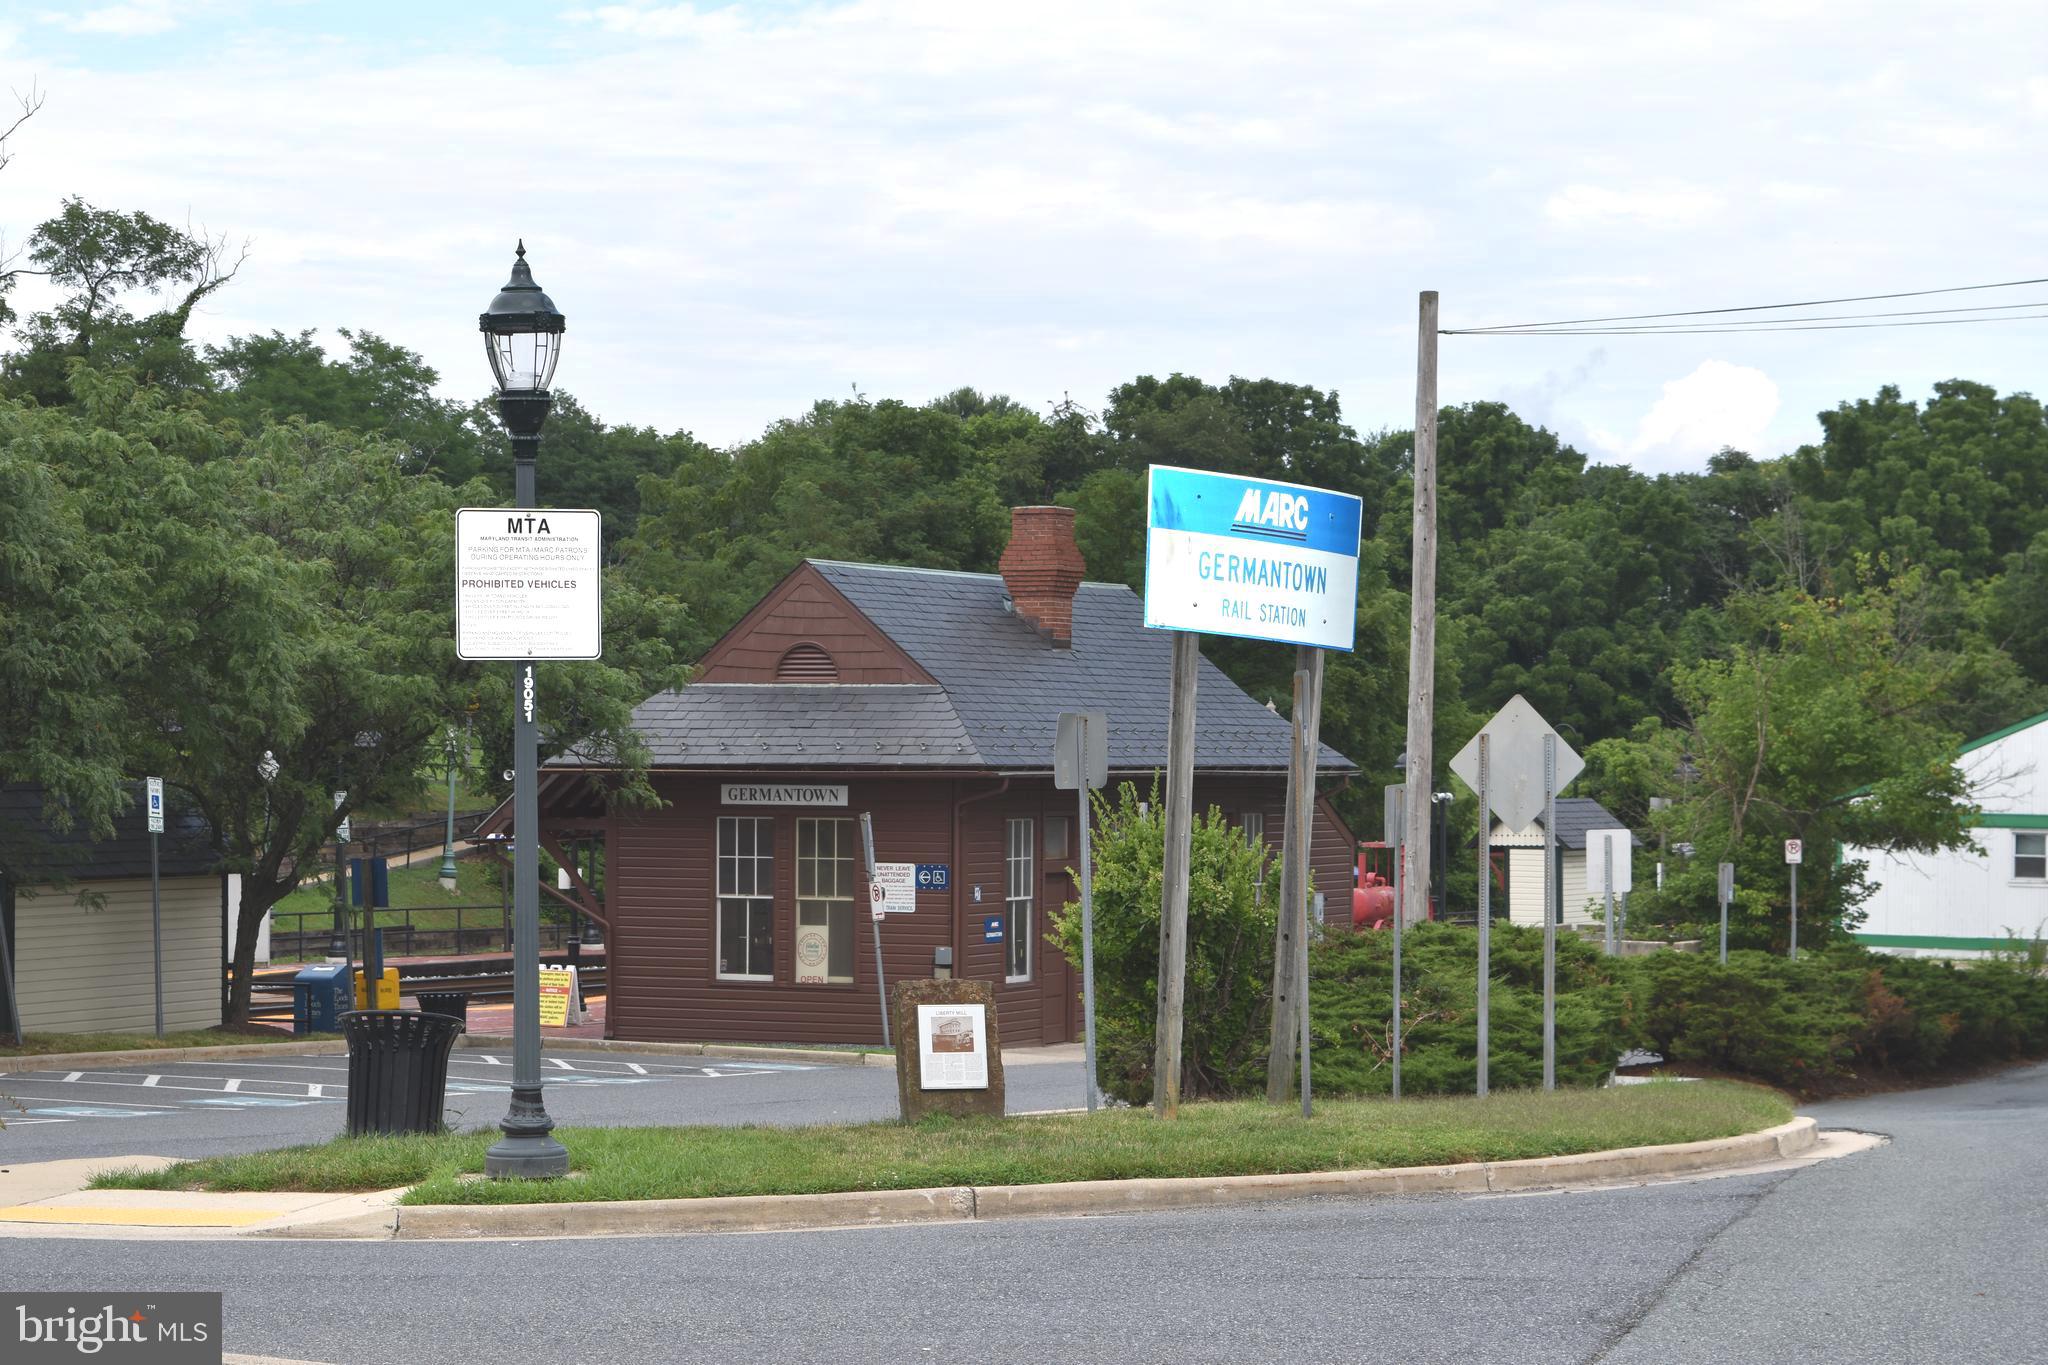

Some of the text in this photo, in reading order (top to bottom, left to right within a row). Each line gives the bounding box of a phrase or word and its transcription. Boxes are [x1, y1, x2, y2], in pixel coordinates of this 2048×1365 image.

[1234, 488, 1309, 530] MARC
[508, 518, 551, 534] MTA
[462, 579, 578, 589] PROHIBITED VEHICLES
[1198, 551, 1327, 595] GERMANTOWN
[1222, 598, 1306, 628] RAIL STATION
[523, 665, 534, 723] 19051
[728, 787, 840, 802] GERMANTOWN
[800, 975, 824, 984] OPEN
